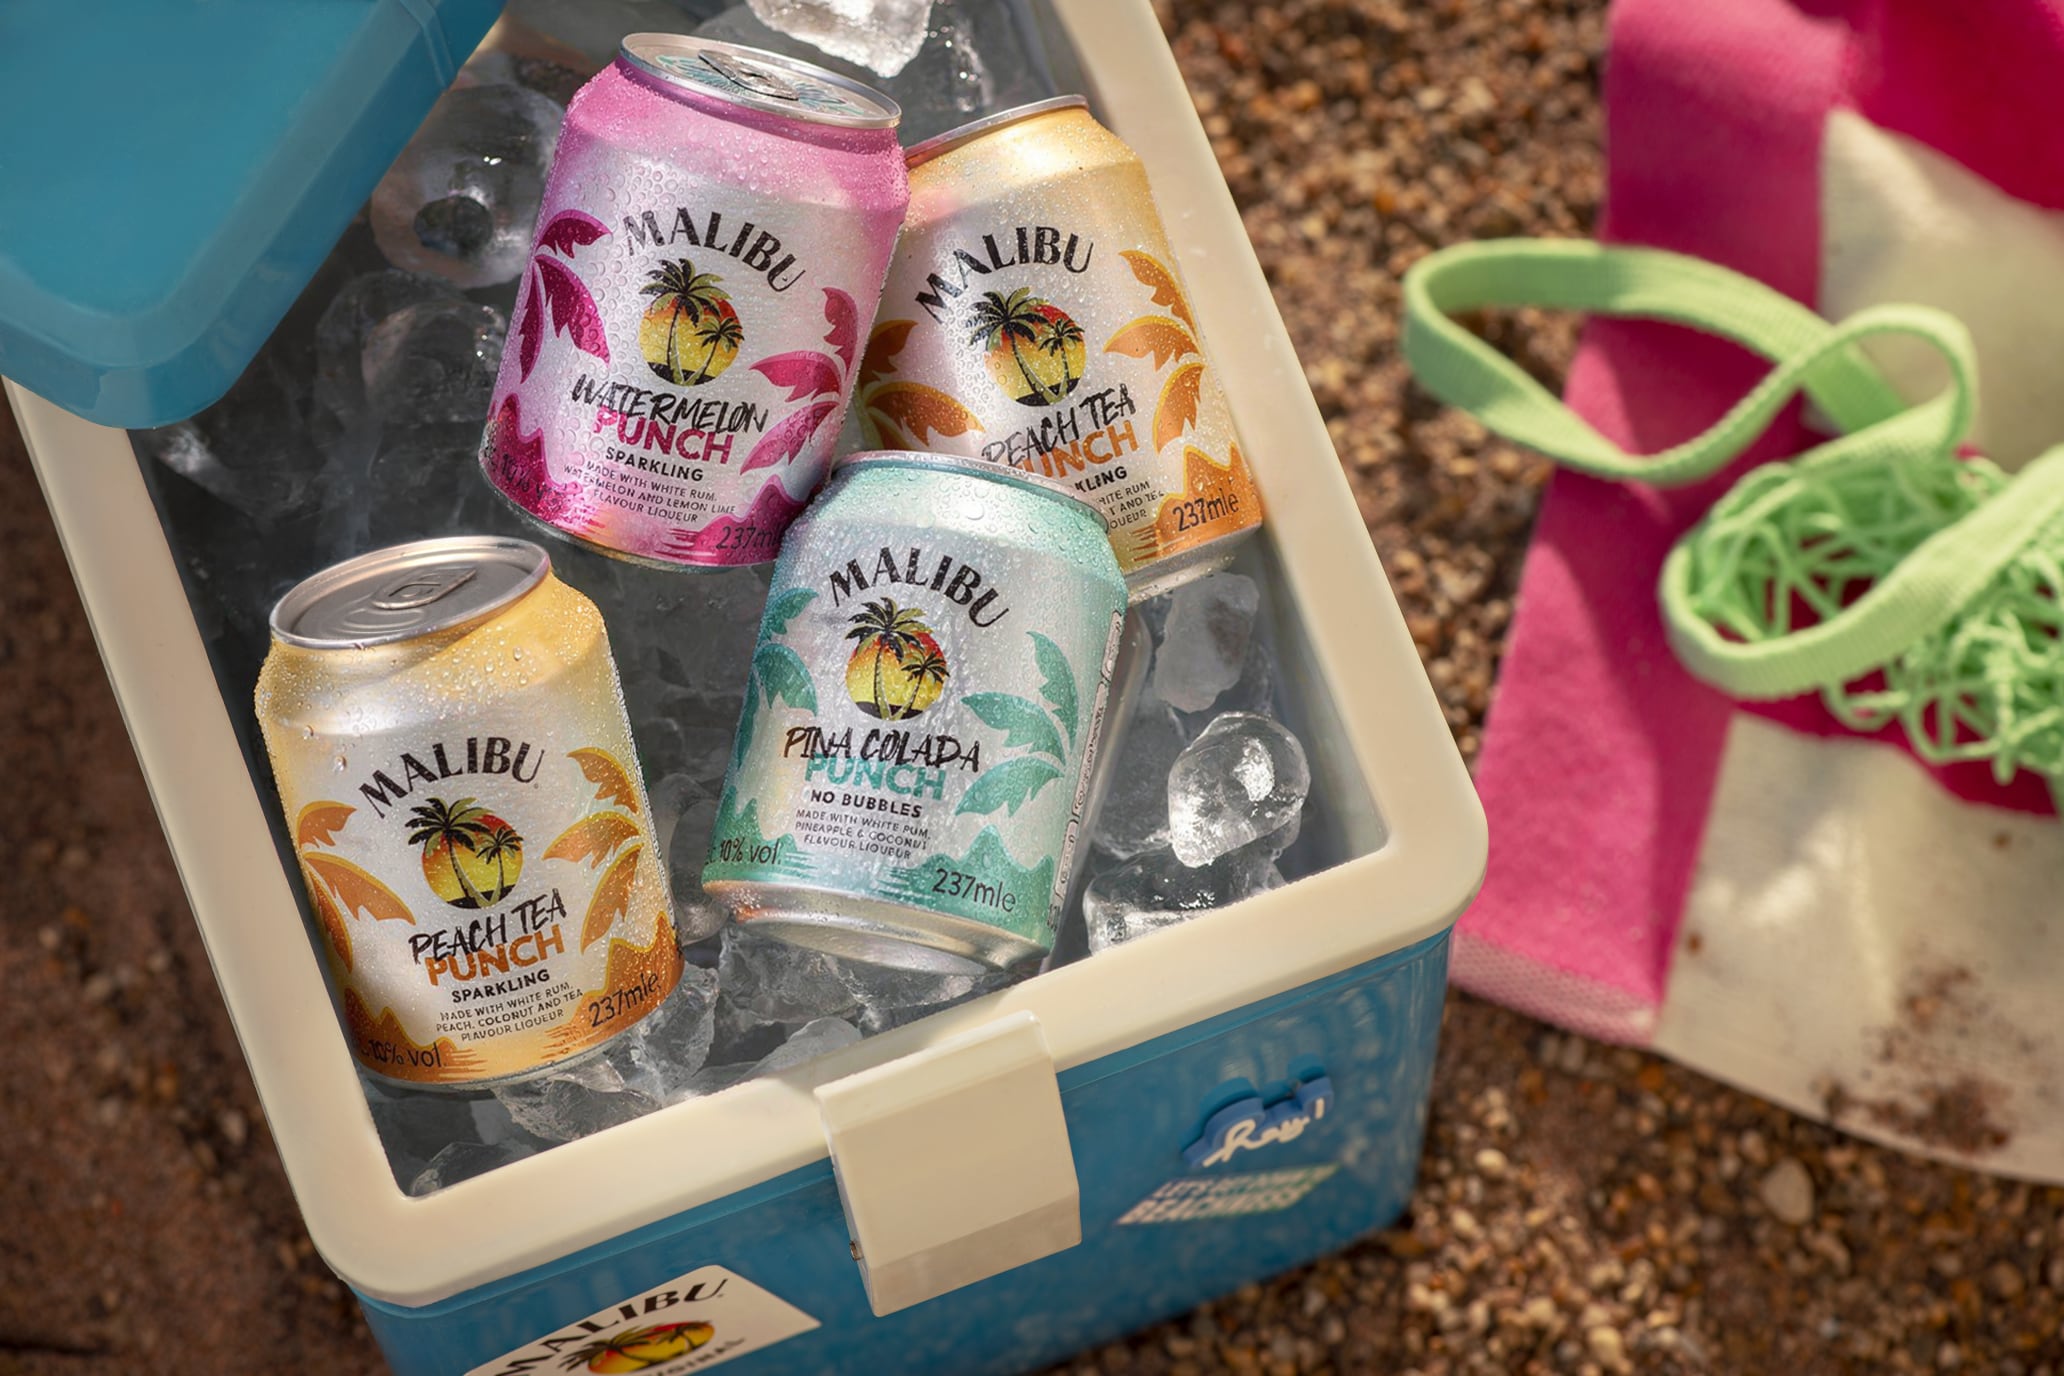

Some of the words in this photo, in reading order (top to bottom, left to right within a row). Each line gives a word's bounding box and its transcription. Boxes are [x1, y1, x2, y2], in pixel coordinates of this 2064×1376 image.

[622, 207, 805, 292] MALIBU
[915, 226, 1094, 325] MALIBU
[571, 374, 768, 434] WATERMELON
[981, 406, 1080, 467] PEACH
[1080, 383, 1137, 425] TEA
[593, 405, 734, 465] PUNCH
[1016, 420, 1139, 478] UNCH
[587, 461, 616, 479] MADE
[620, 473, 647, 487] WITH
[651, 481, 686, 497] WHITE
[606, 447, 704, 482] SPARKLING
[563, 465, 634, 498] WATERMELON
[638, 492, 663, 505] AND
[667, 498, 708, 512] LEMON
[712, 505, 736, 514] LIME
[593, 489, 643, 513] FLAVOUR
[647, 506, 698, 523] LIQUEUR
[1120, 497, 1143, 512] AND
[828, 546, 1010, 628] MALIBU
[860, 728, 981, 773] COLADA
[359, 737, 545, 819] MALIBU
[804, 753, 947, 801] PUNCH
[796, 809, 826, 820] MADE
[830, 813, 857, 824] WITH
[861, 818, 899, 832] WHITE
[810, 790, 836, 804] NO
[842, 795, 923, 819] BUBBLES
[795, 821, 853, 837] PINEAPPLE
[804, 834, 855, 849] FLAVOUR
[859, 841, 912, 859] LIQUEUR
[408, 913, 508, 965] PEACH
[510, 887, 567, 932] TEA
[424, 924, 565, 986] PUNCH
[440, 1009, 472, 1022] MADE
[475, 1003, 504, 1016] WITH
[506, 992, 542, 1009] WHITE
[451, 969, 551, 1003] SPARKLING
[478, 1006, 535, 1027] COCONUT
[537, 997, 561, 1013] AND
[563, 989, 584, 1002] TEA
[514, 1009, 564, 1033] LIQUEUR
[494, 1278, 729, 1376] MALIBU
